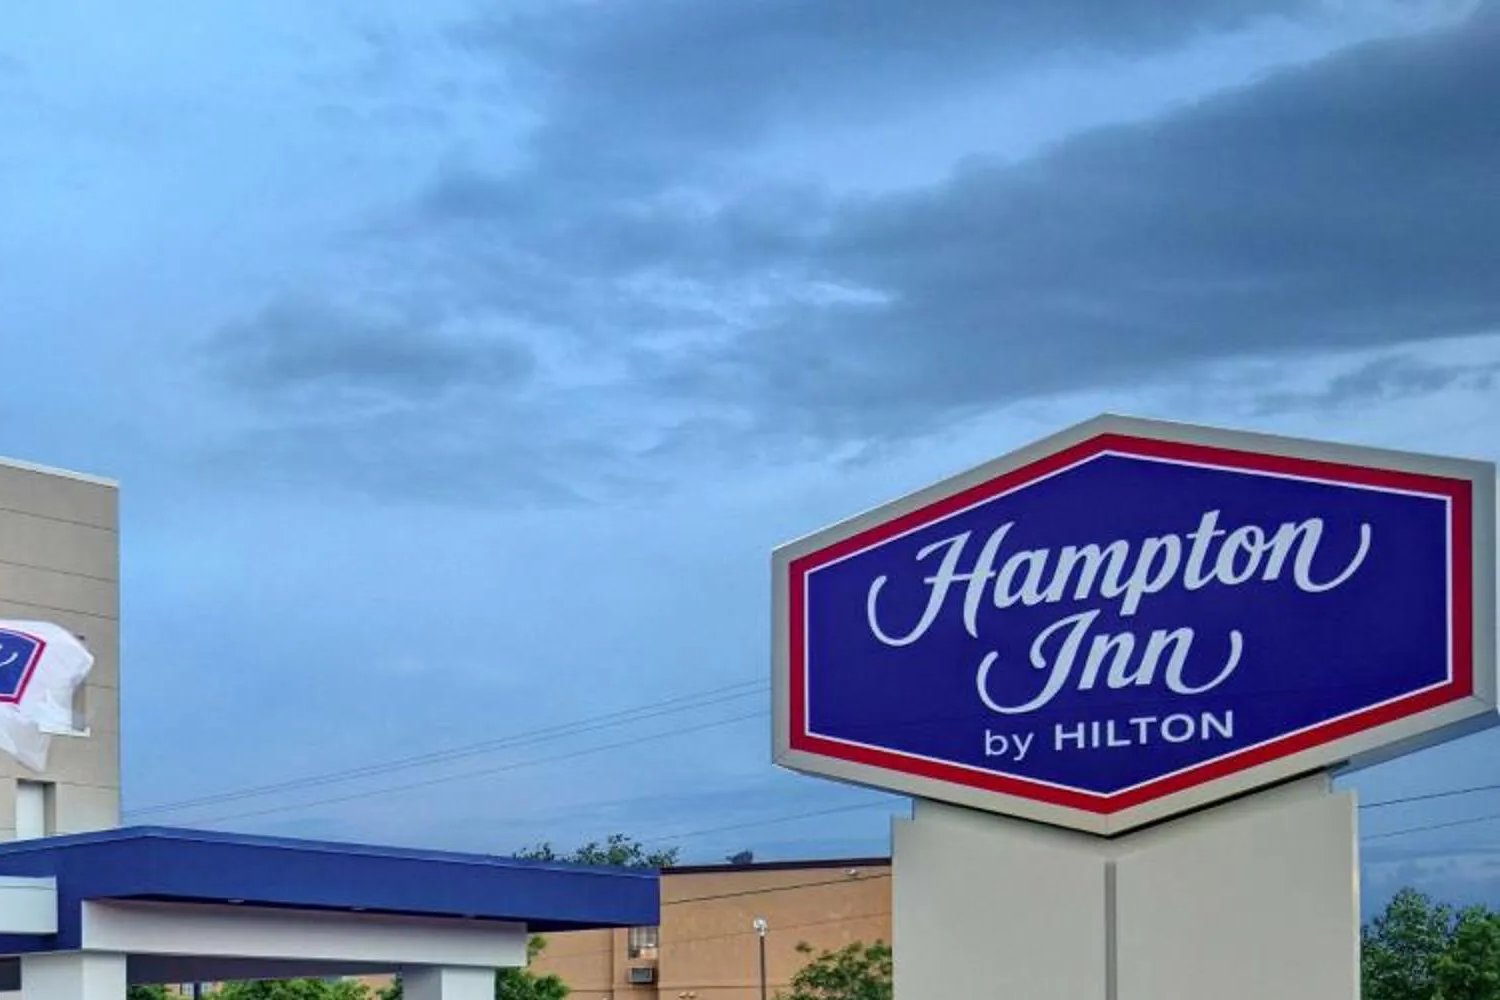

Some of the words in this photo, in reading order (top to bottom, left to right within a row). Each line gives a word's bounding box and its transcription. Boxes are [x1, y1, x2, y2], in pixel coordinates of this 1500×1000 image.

[868, 510, 1370, 645] Hampton
[977, 610, 1242, 713] Inn
[985, 729, 1034, 760] by
[1054, 710, 1234, 751] HILTON
